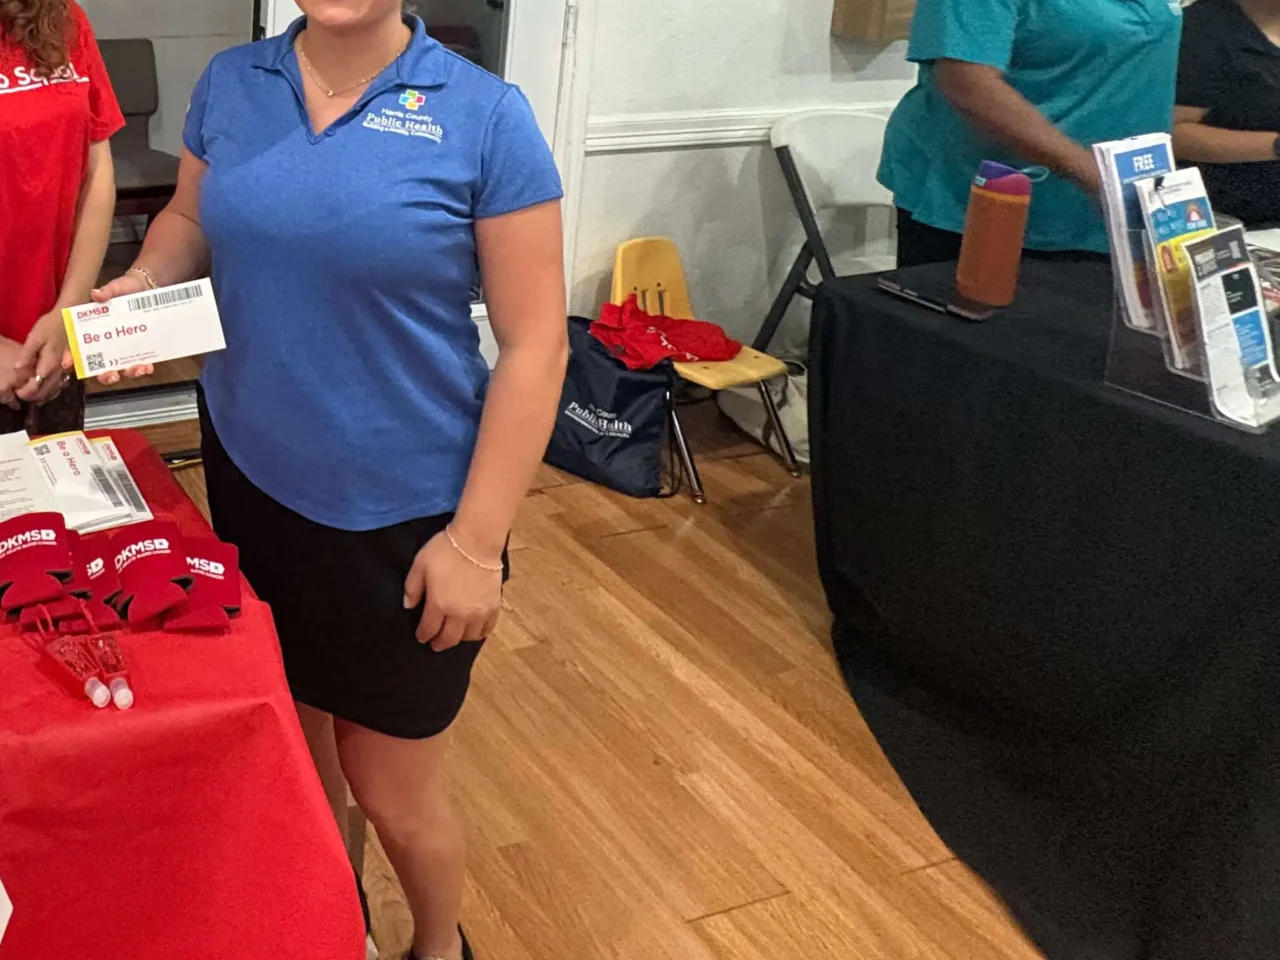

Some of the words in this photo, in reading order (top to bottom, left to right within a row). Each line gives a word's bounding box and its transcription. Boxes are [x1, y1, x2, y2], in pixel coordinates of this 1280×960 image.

[366, 113, 402, 127] Public
[405, 120, 444, 136] Health
[1132, 153, 1155, 173] FREE
[83, 332, 100, 345] Be
[104, 329, 113, 340] a
[115, 323, 148, 338] Hero
